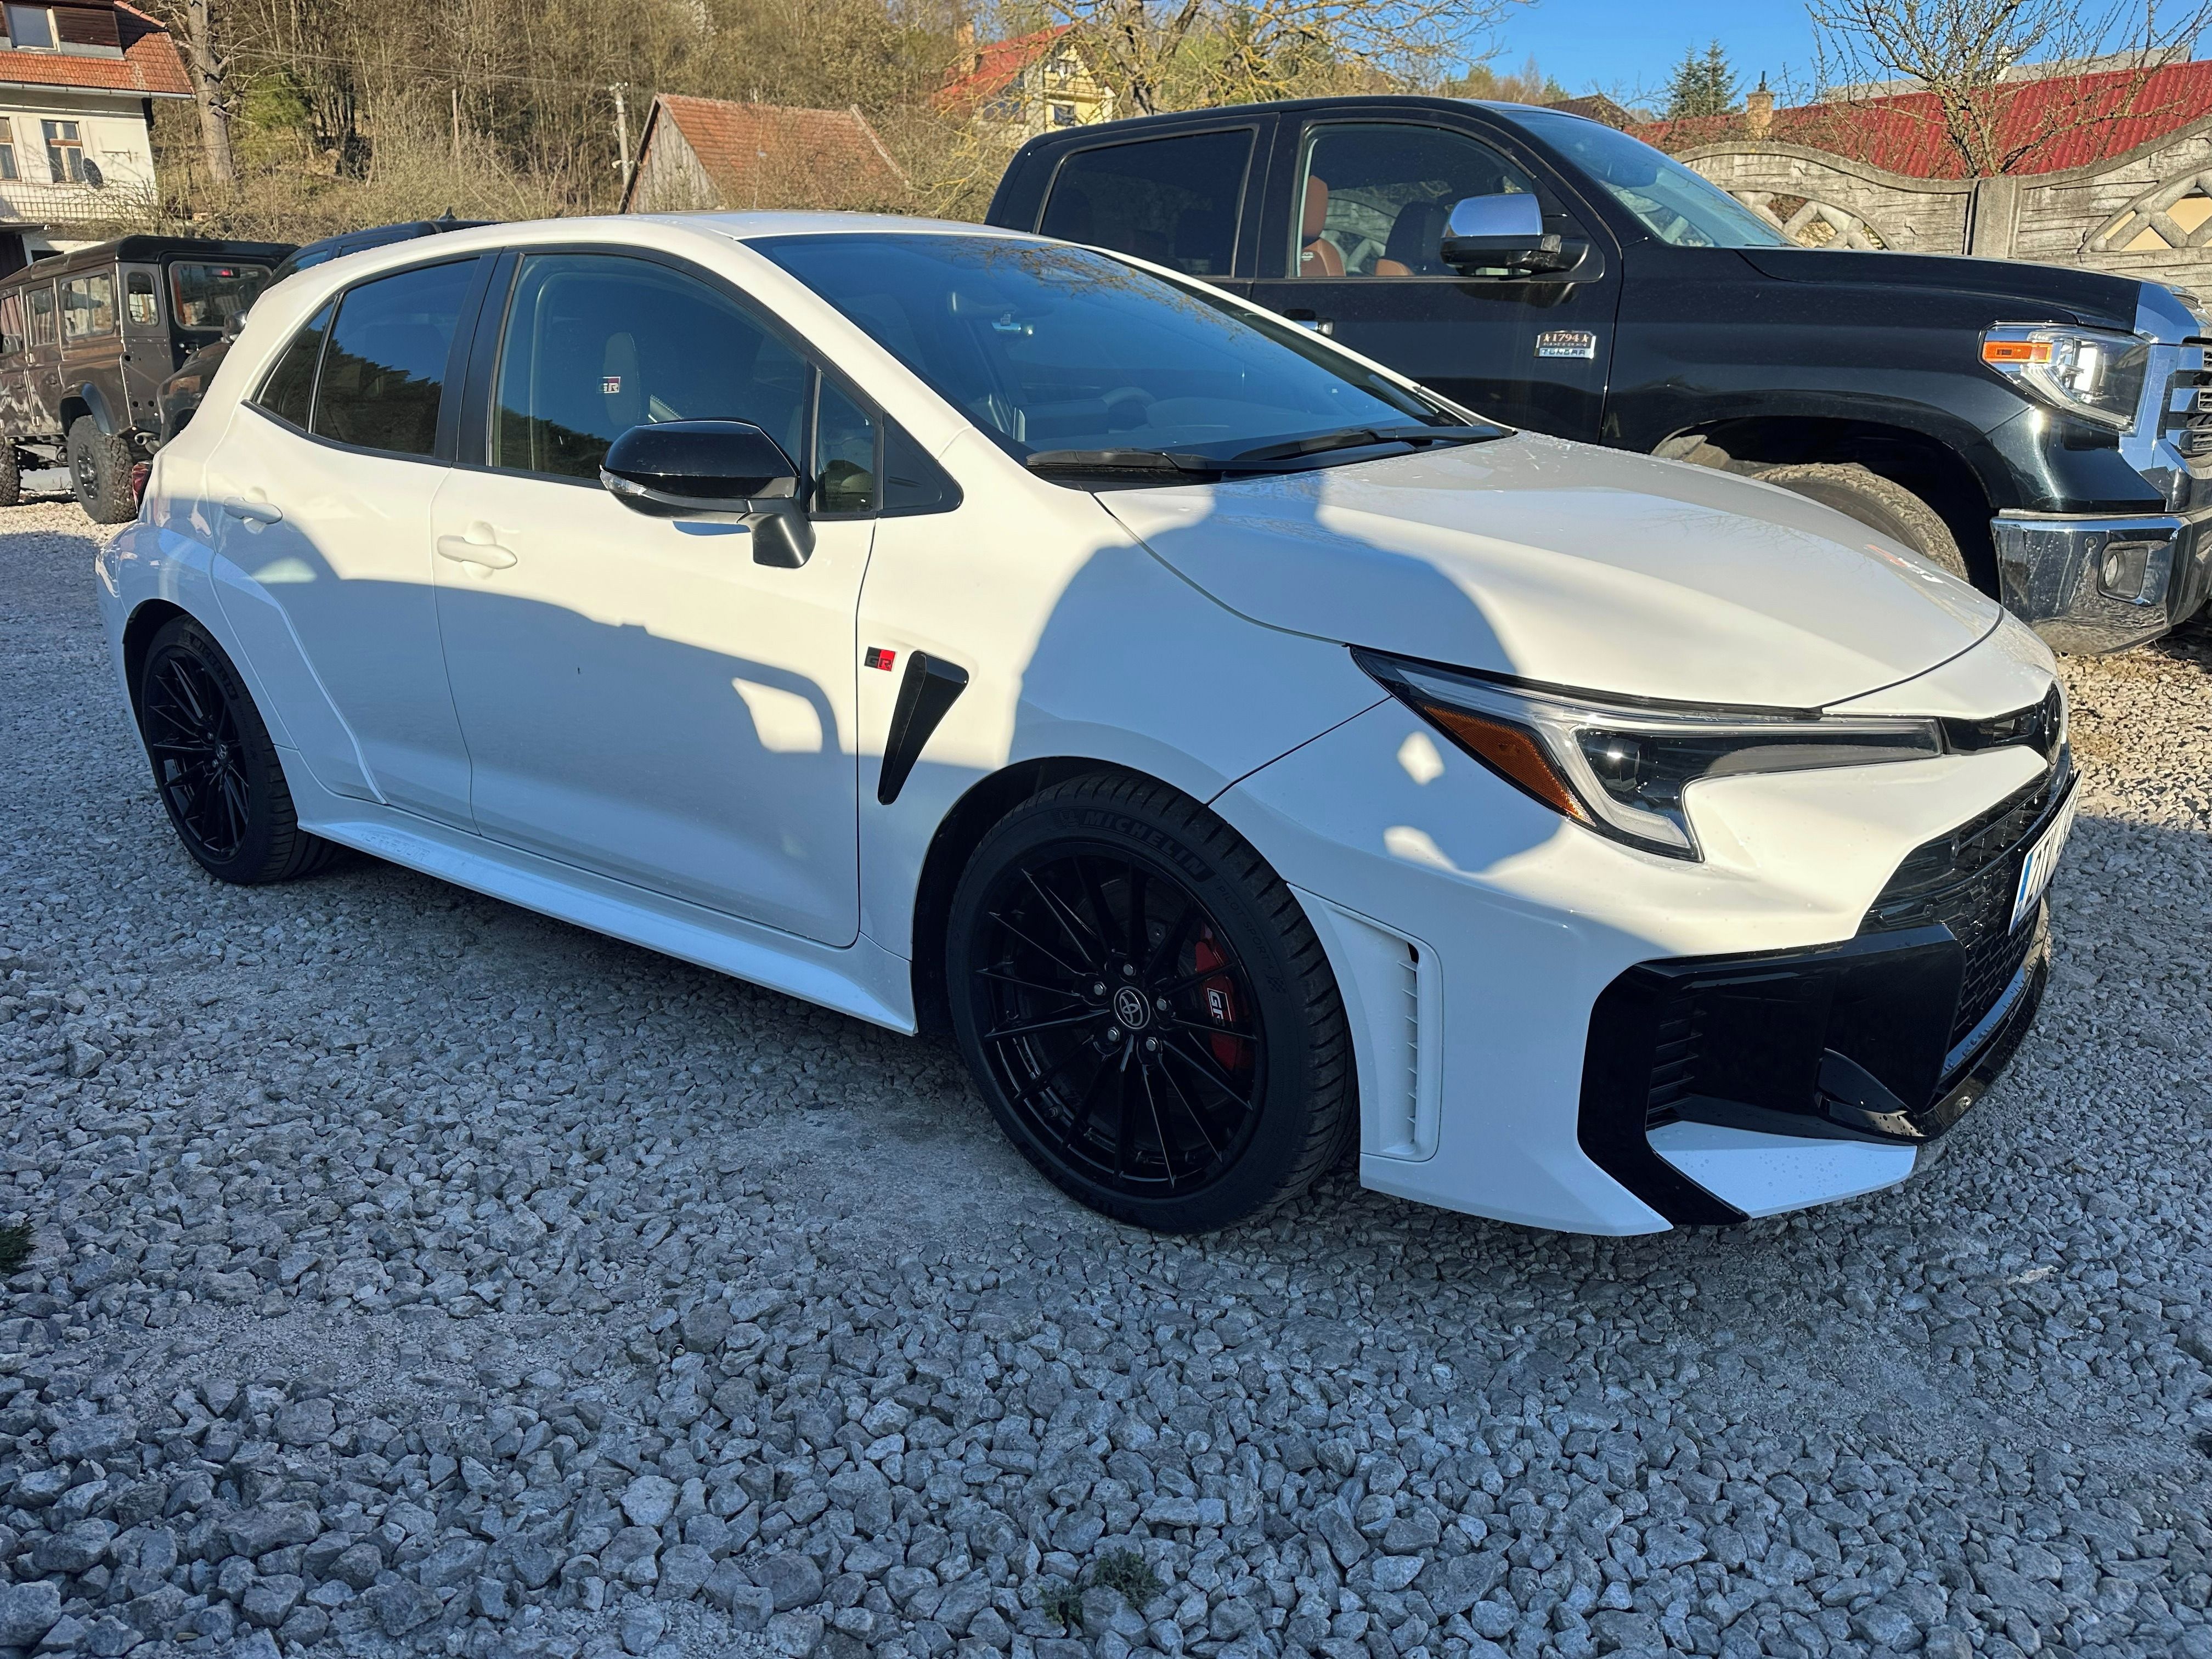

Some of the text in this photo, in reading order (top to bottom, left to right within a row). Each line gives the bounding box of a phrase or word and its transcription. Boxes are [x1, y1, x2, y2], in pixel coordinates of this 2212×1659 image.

[1552, 333, 1579, 342] 1794
[599, 382, 619, 392] GR
[867, 655, 893, 669] GR
[1084, 810, 1206, 875] MICHELIN
[1215, 885, 1246, 917] PILOT
[1243, 921, 1272, 962] SPORT
